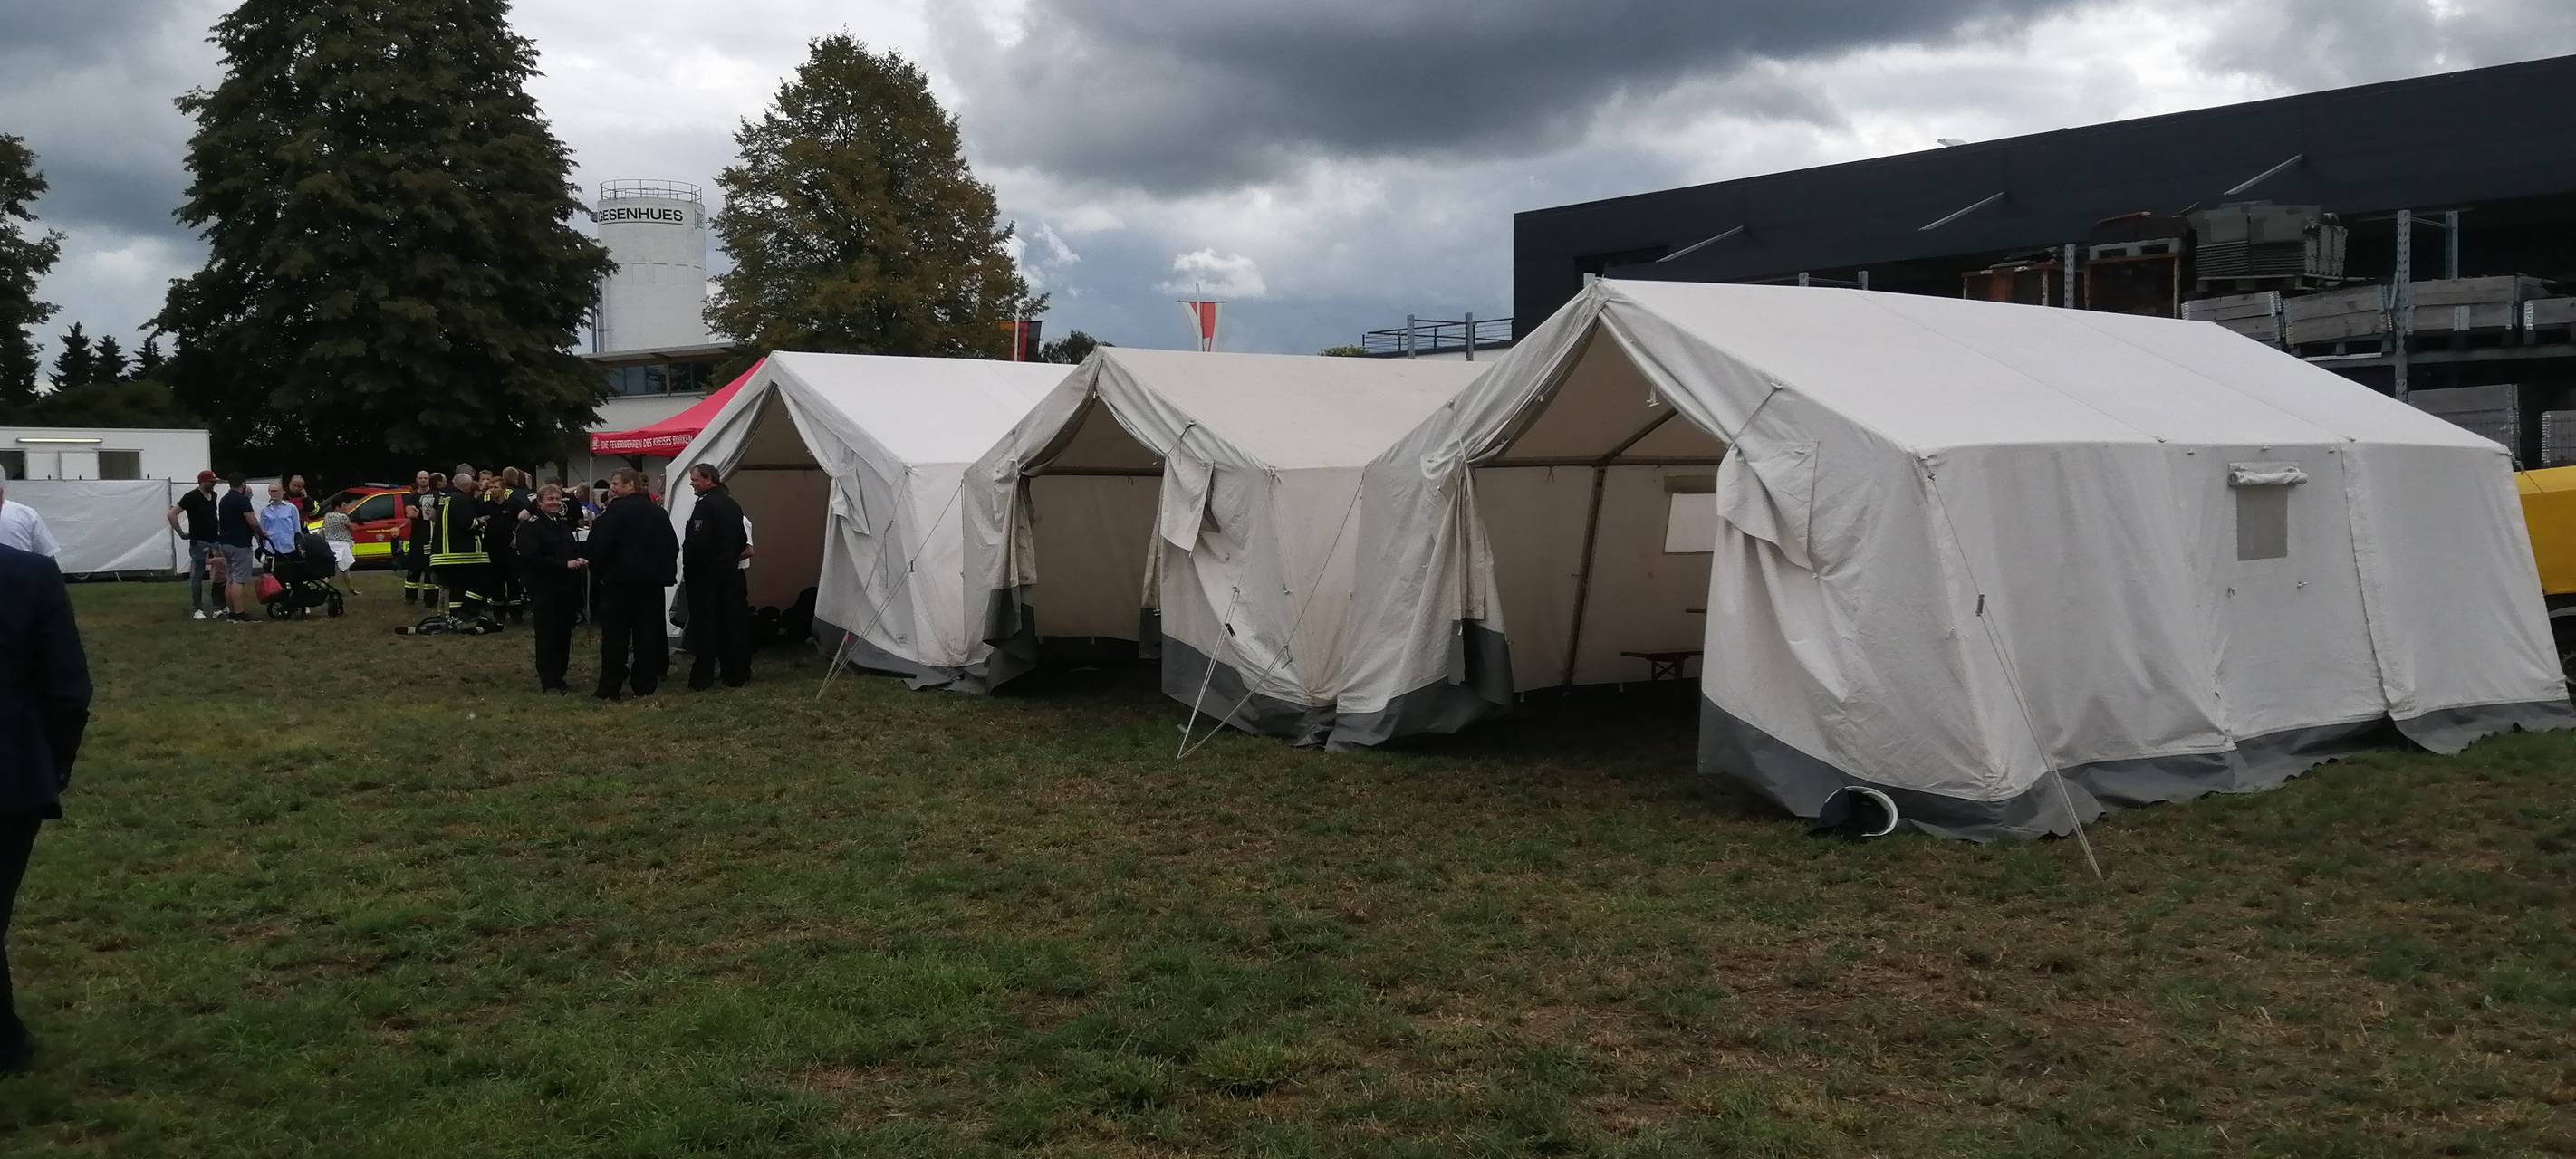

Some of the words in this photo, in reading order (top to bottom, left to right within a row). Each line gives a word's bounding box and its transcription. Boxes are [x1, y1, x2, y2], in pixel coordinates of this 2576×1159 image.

[599, 207, 683, 222] GESENHUES
[601, 440, 609, 449] DIE
[643, 437, 652, 447] DES
[652, 436, 672, 446] KREISES
